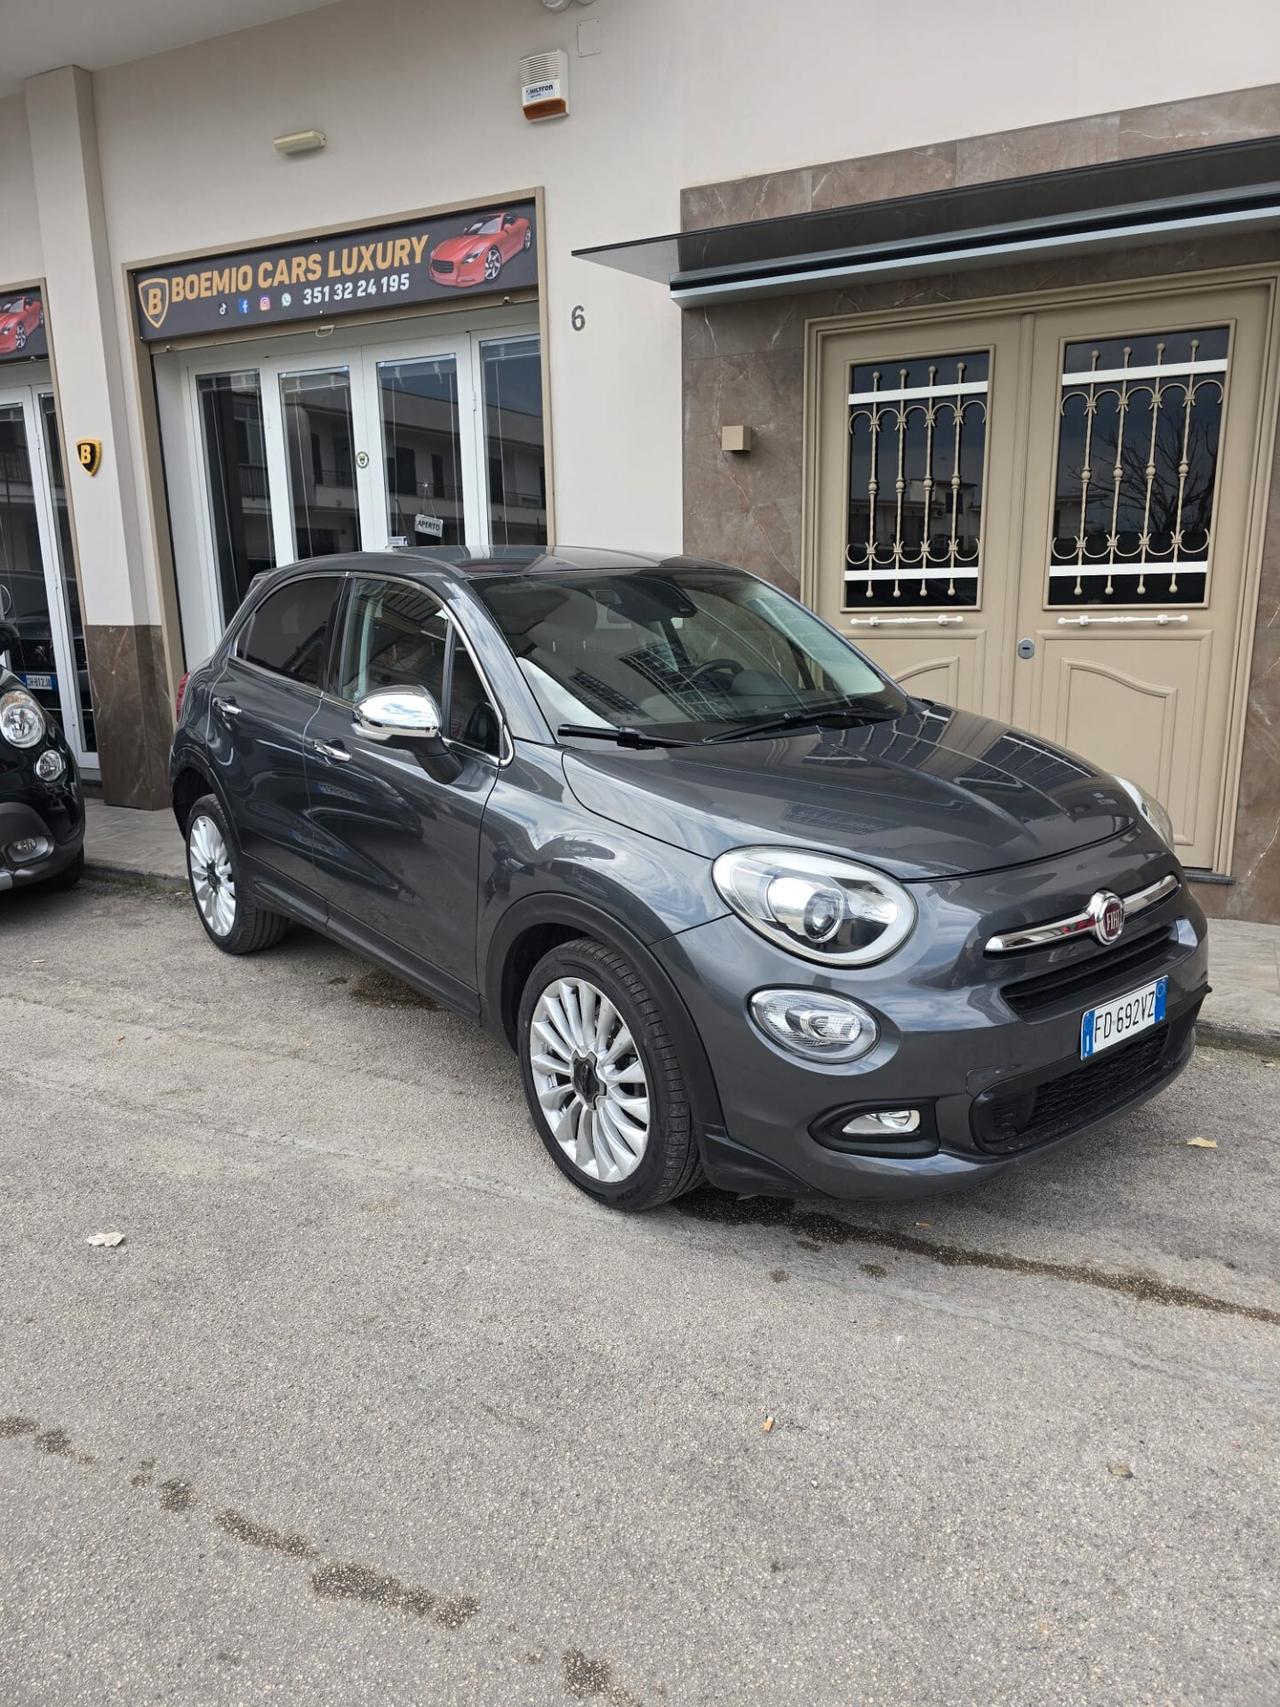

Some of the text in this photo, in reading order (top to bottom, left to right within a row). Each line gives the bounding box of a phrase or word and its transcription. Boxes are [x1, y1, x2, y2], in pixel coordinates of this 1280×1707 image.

[171, 234, 430, 303] BOEMIO CARS LUXURY
[147, 287, 162, 316] B
[303, 272, 410, 305] 351 32 24 195
[571, 304, 586, 331] 6
[80, 443, 91, 464] B
[417, 520, 440, 531] APERTO
